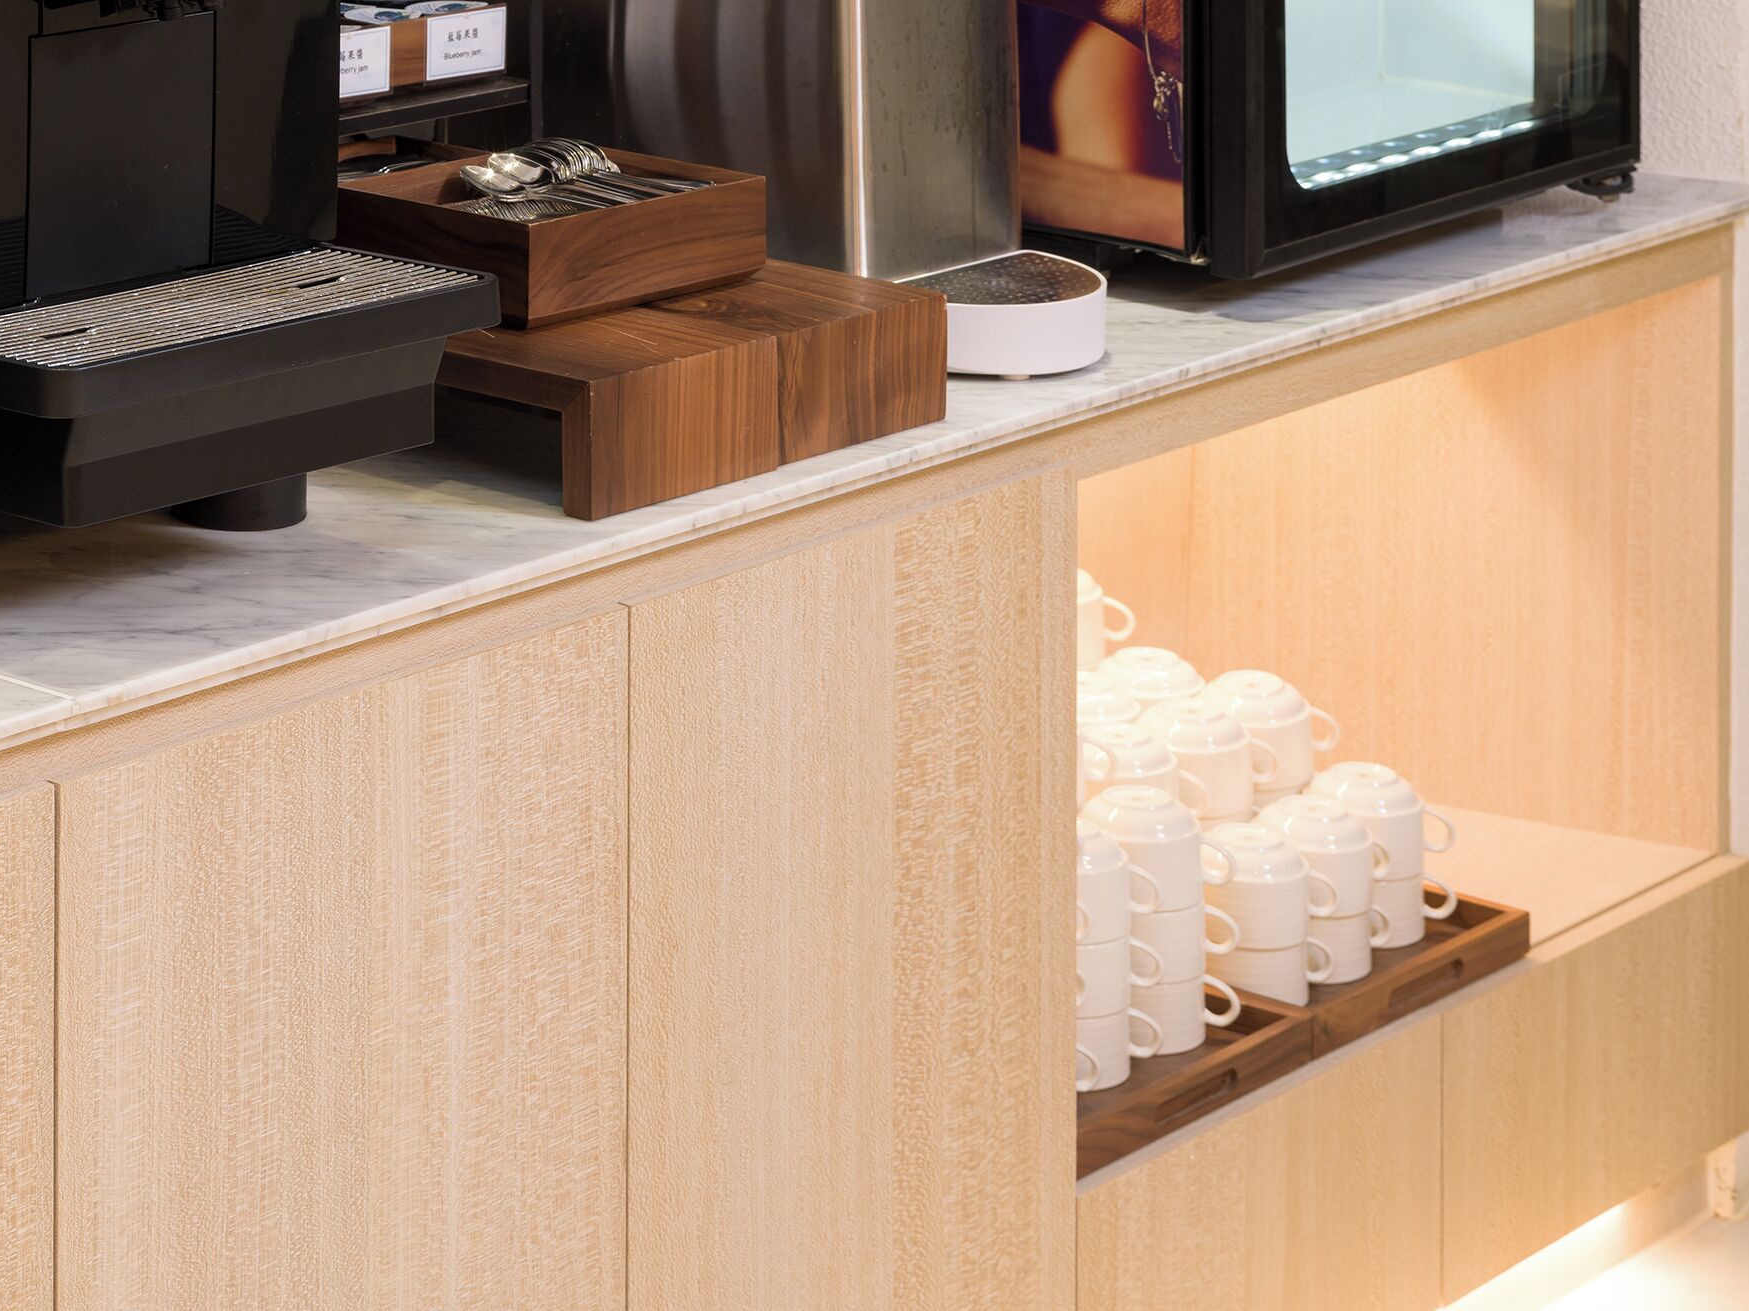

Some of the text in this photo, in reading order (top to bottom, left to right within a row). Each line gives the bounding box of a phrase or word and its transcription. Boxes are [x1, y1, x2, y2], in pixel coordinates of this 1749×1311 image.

[340, 49, 363, 62] 莓果醬
[444, 49, 481, 60] Blueberry jam
[340, 65, 369, 75] berry jam
